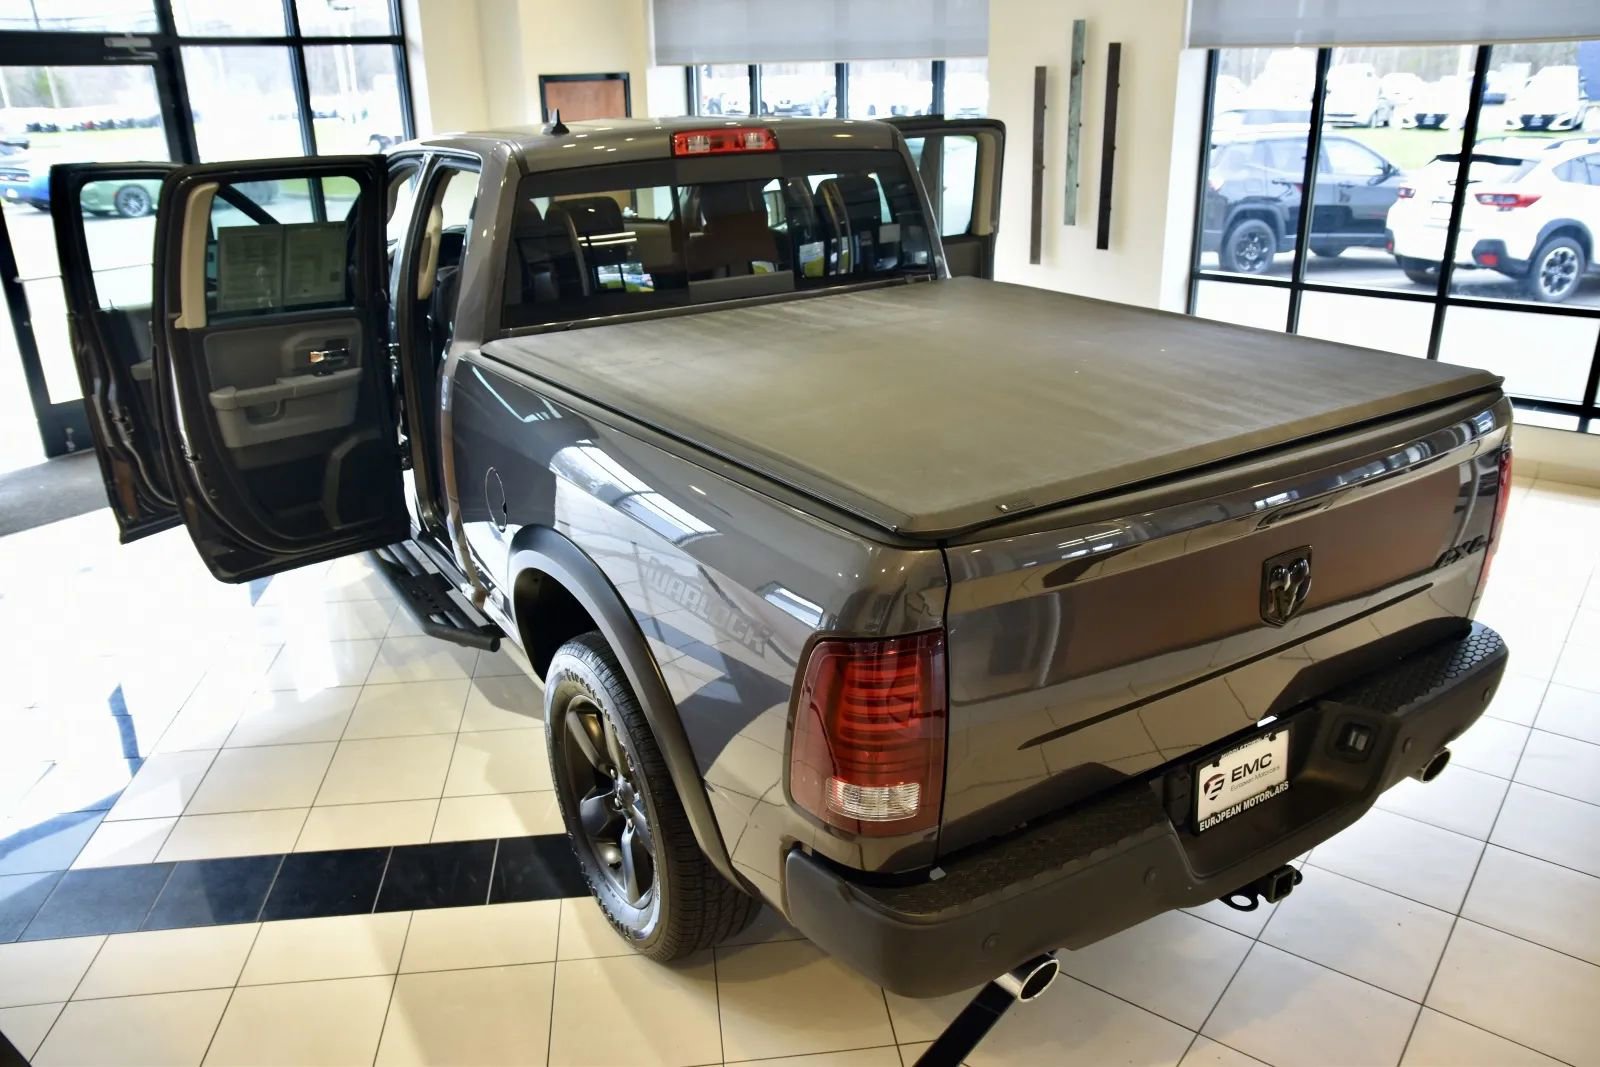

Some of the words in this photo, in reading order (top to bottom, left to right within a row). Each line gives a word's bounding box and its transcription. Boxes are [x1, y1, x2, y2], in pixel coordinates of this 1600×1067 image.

[642, 570, 767, 657] WARLOCK
[1231, 753, 1272, 782] EMC
[1199, 804, 1242, 832] EUROPEAN
[1243, 780, 1289, 808] MOTORCARS
